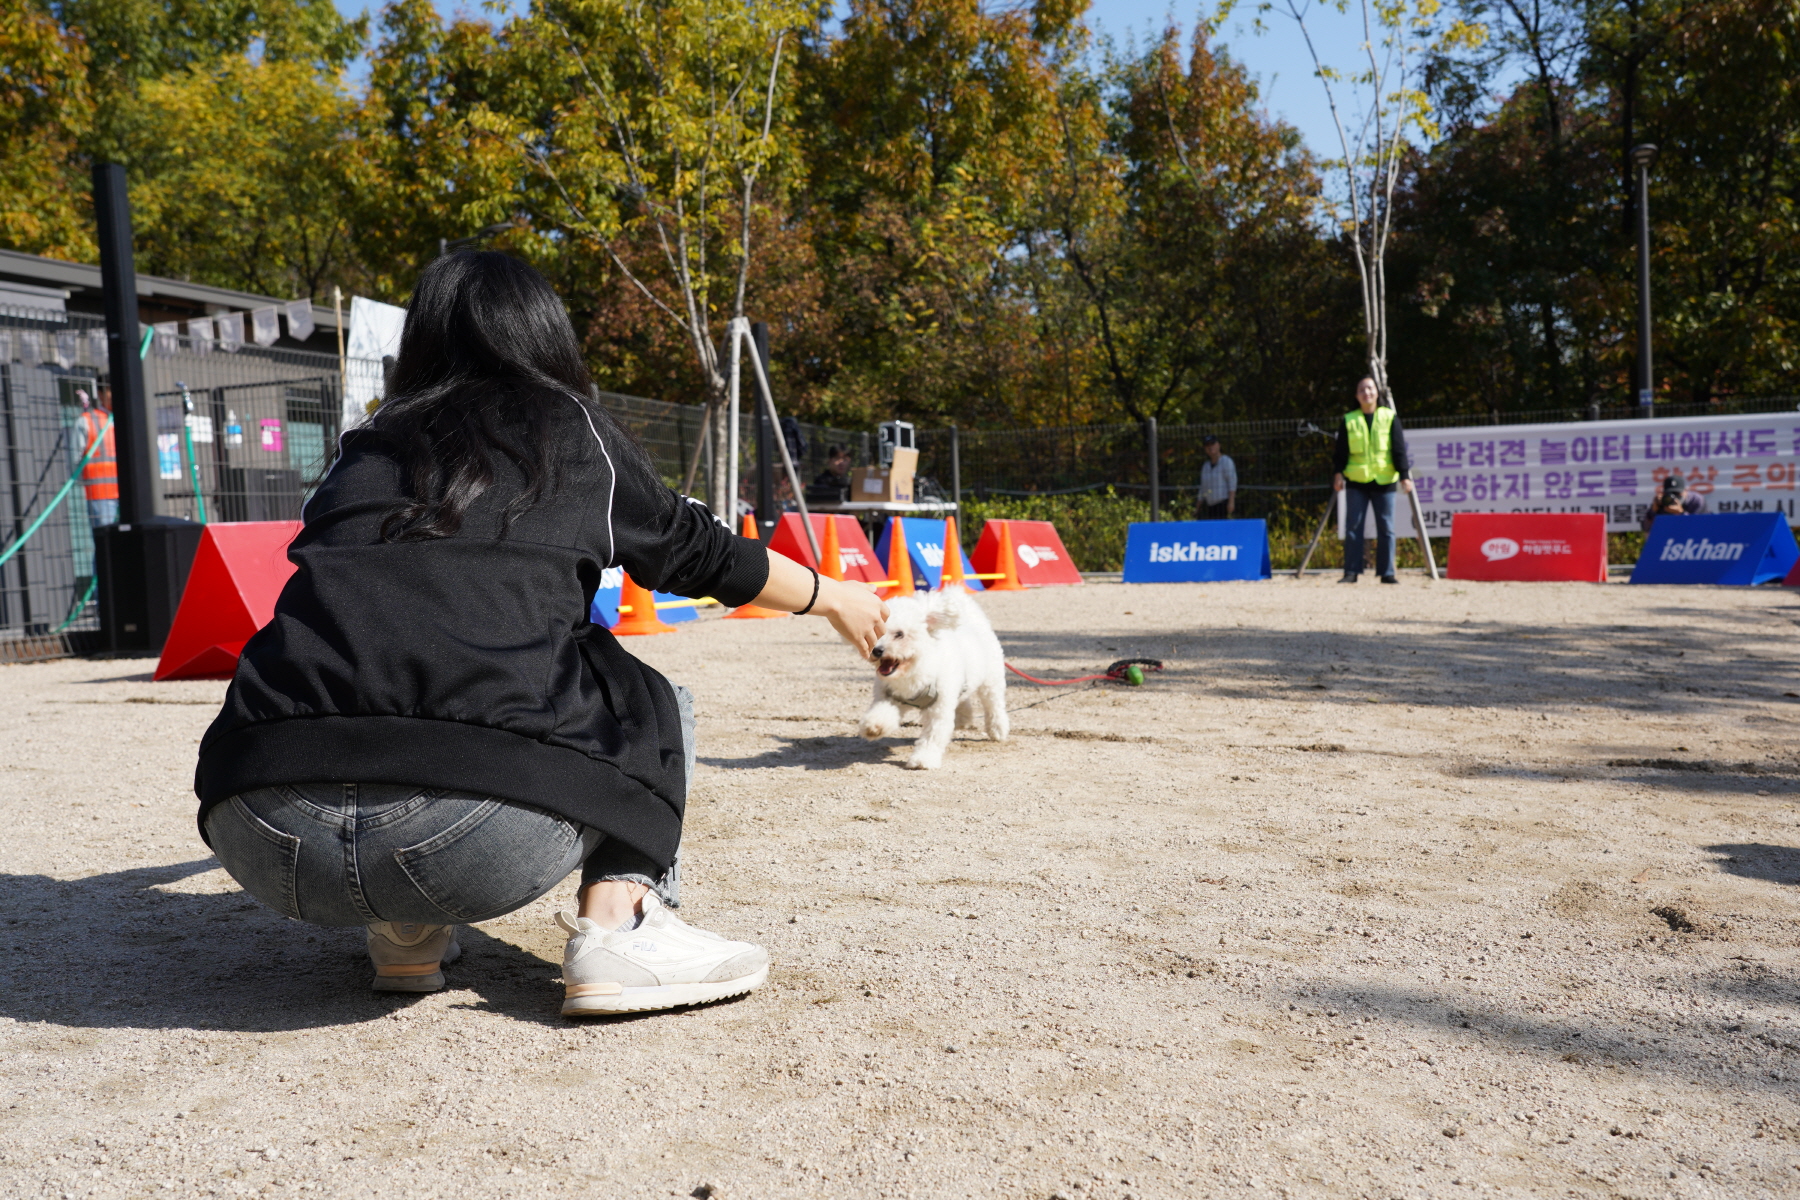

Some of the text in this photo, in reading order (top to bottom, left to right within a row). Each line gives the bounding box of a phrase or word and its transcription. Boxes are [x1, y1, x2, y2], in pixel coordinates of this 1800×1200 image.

[1436, 439, 1526, 469] 반려견
[1539, 434, 1630, 465] 놀이터
[1645, 428, 1777, 461] 내에서도
[1413, 472, 1530, 504] 발생하지
[1543, 468, 1638, 499] 않도록
[1149, 541, 1238, 563] iskhan
[1660, 538, 1744, 561] iskhan
[632, 941, 657, 952] FILA
